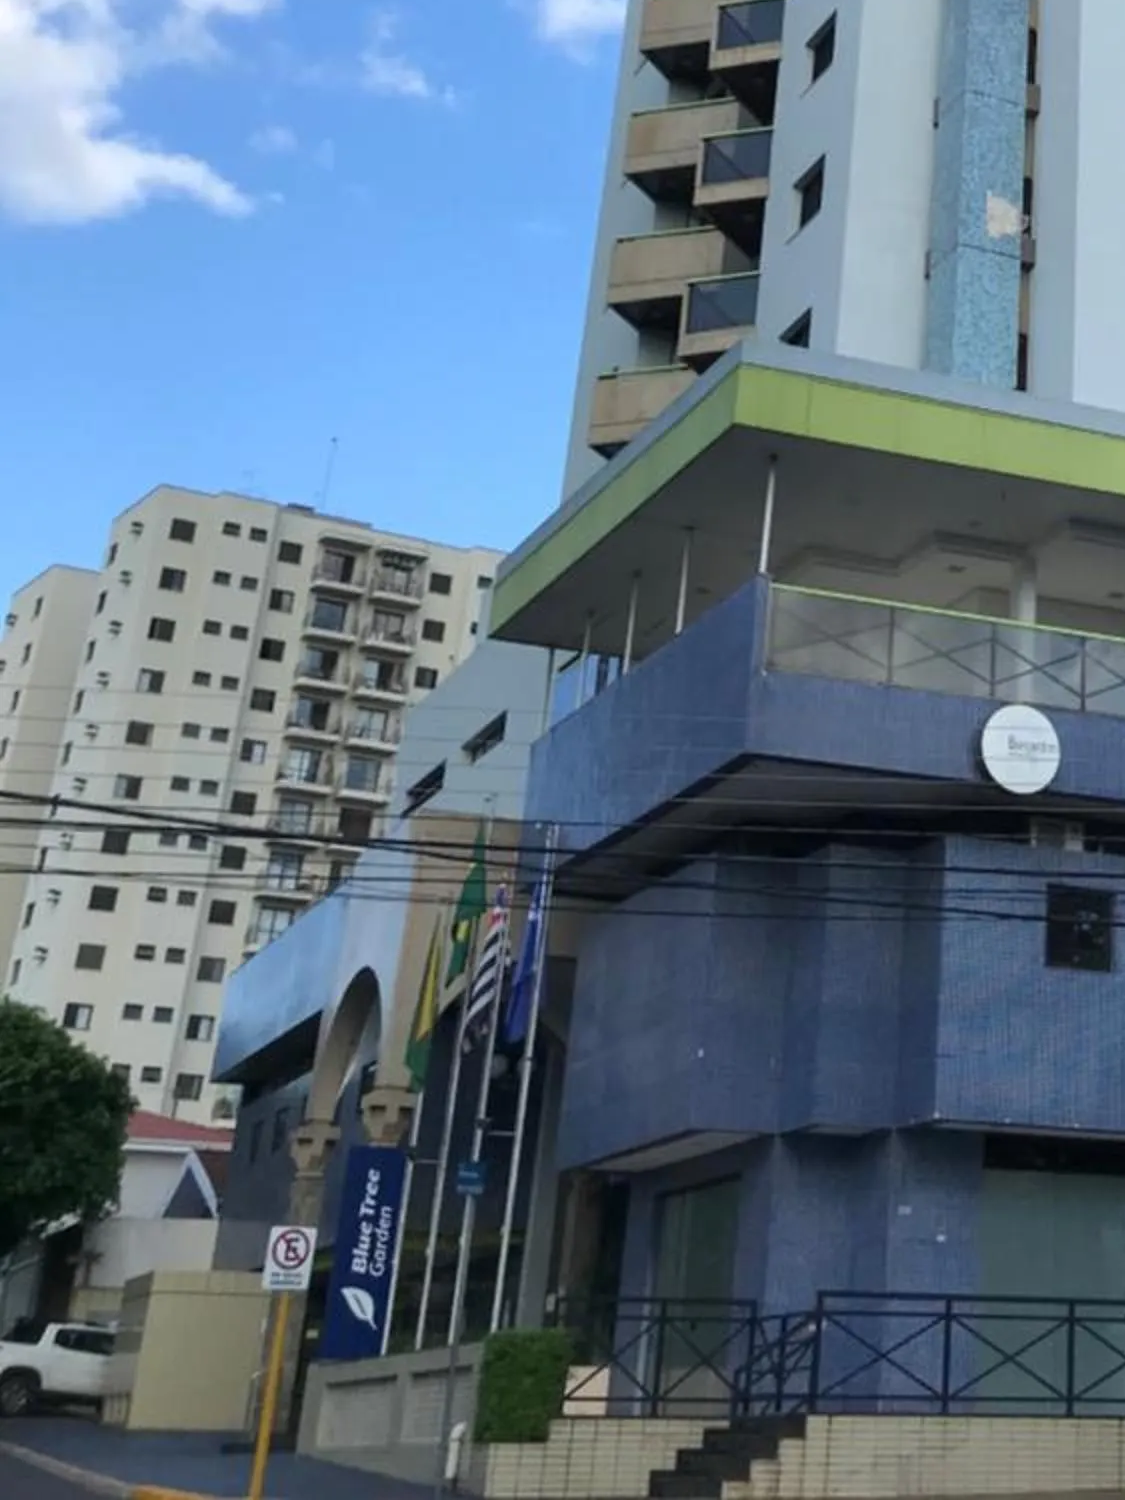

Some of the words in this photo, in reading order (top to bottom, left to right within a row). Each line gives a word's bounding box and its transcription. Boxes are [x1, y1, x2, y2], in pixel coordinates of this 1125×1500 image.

[359, 1167, 381, 1217] Tree
[351, 1221, 374, 1274] Blue
[369, 1205, 393, 1277] Garden
